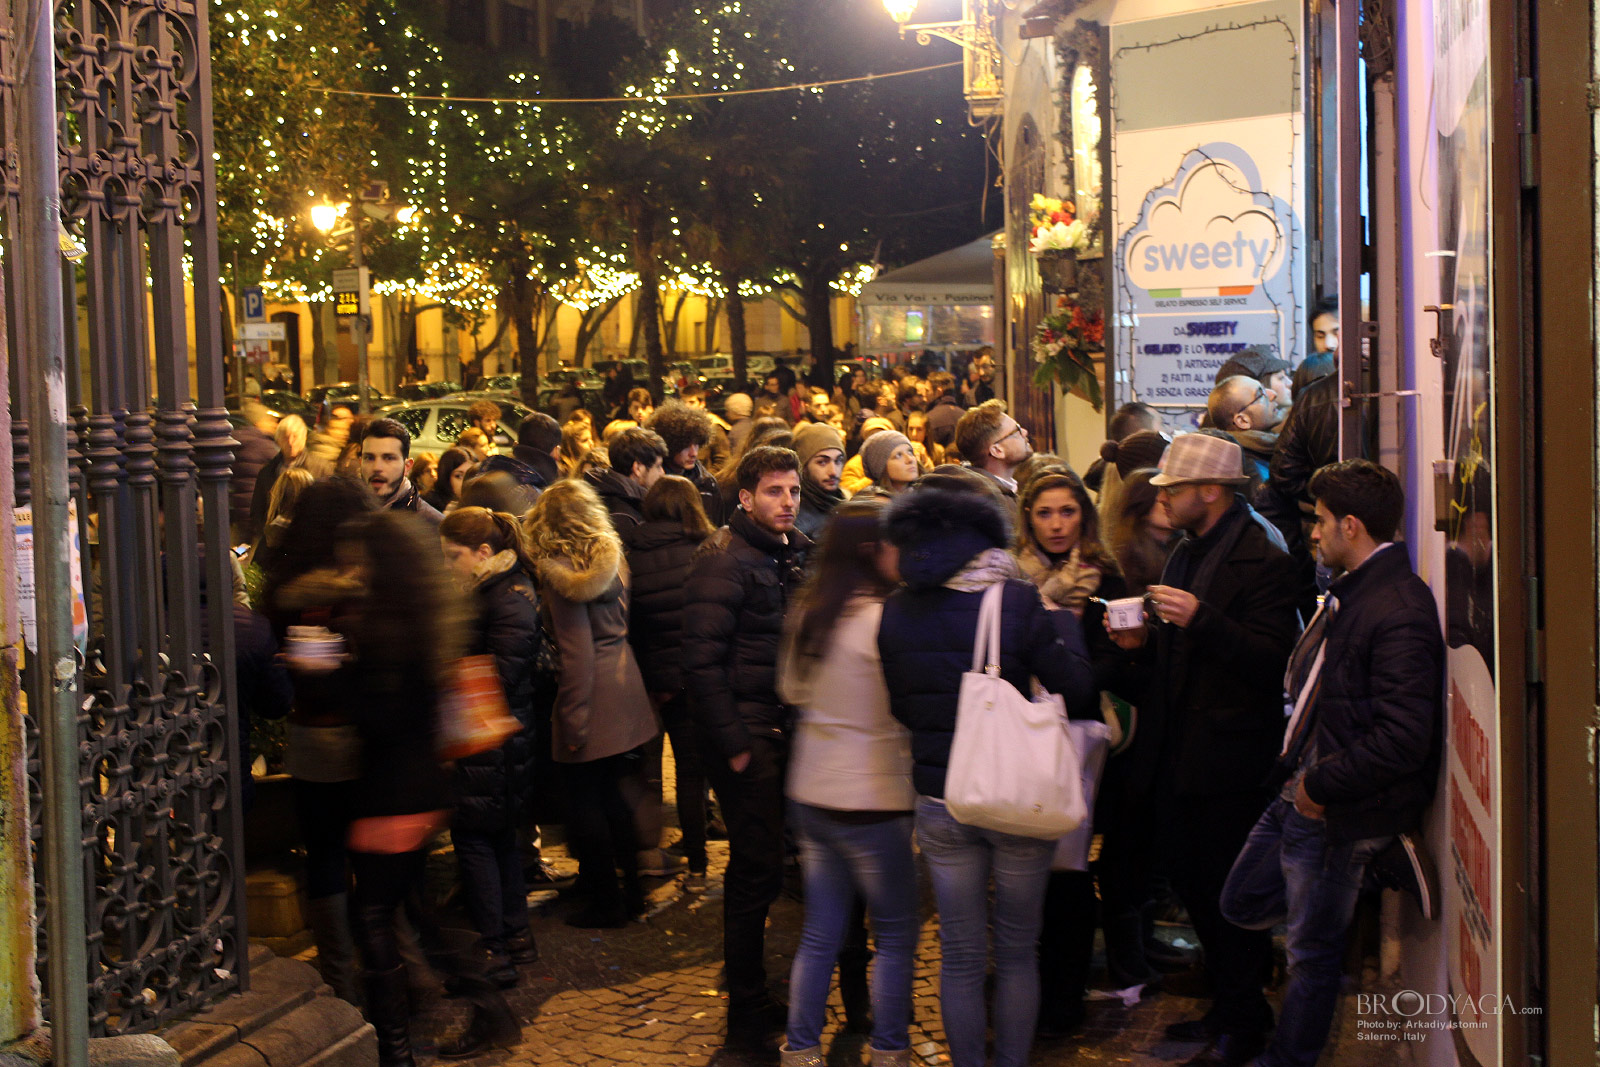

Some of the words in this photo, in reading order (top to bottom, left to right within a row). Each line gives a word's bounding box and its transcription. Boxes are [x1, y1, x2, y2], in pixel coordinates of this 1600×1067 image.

[1144, 231, 1268, 278] sweety
[248, 293, 259, 315] P
[1155, 300, 1178, 308] GELATO
[1179, 299, 1208, 307] ESPRESSO
[1209, 298, 1221, 306] SELF
[1174, 327, 1185, 336] DA
[1186, 321, 1238, 337] SWEETY
[1144, 343, 1182, 355] GELATO
[1184, 344, 1189, 353] E
[1191, 344, 1203, 354] LO
[1184, 359, 1227, 369] ARTIGIAN
[1170, 373, 1192, 383] FATTI
[1194, 373, 1205, 383] AL
[1156, 387, 1182, 397] SENZA
